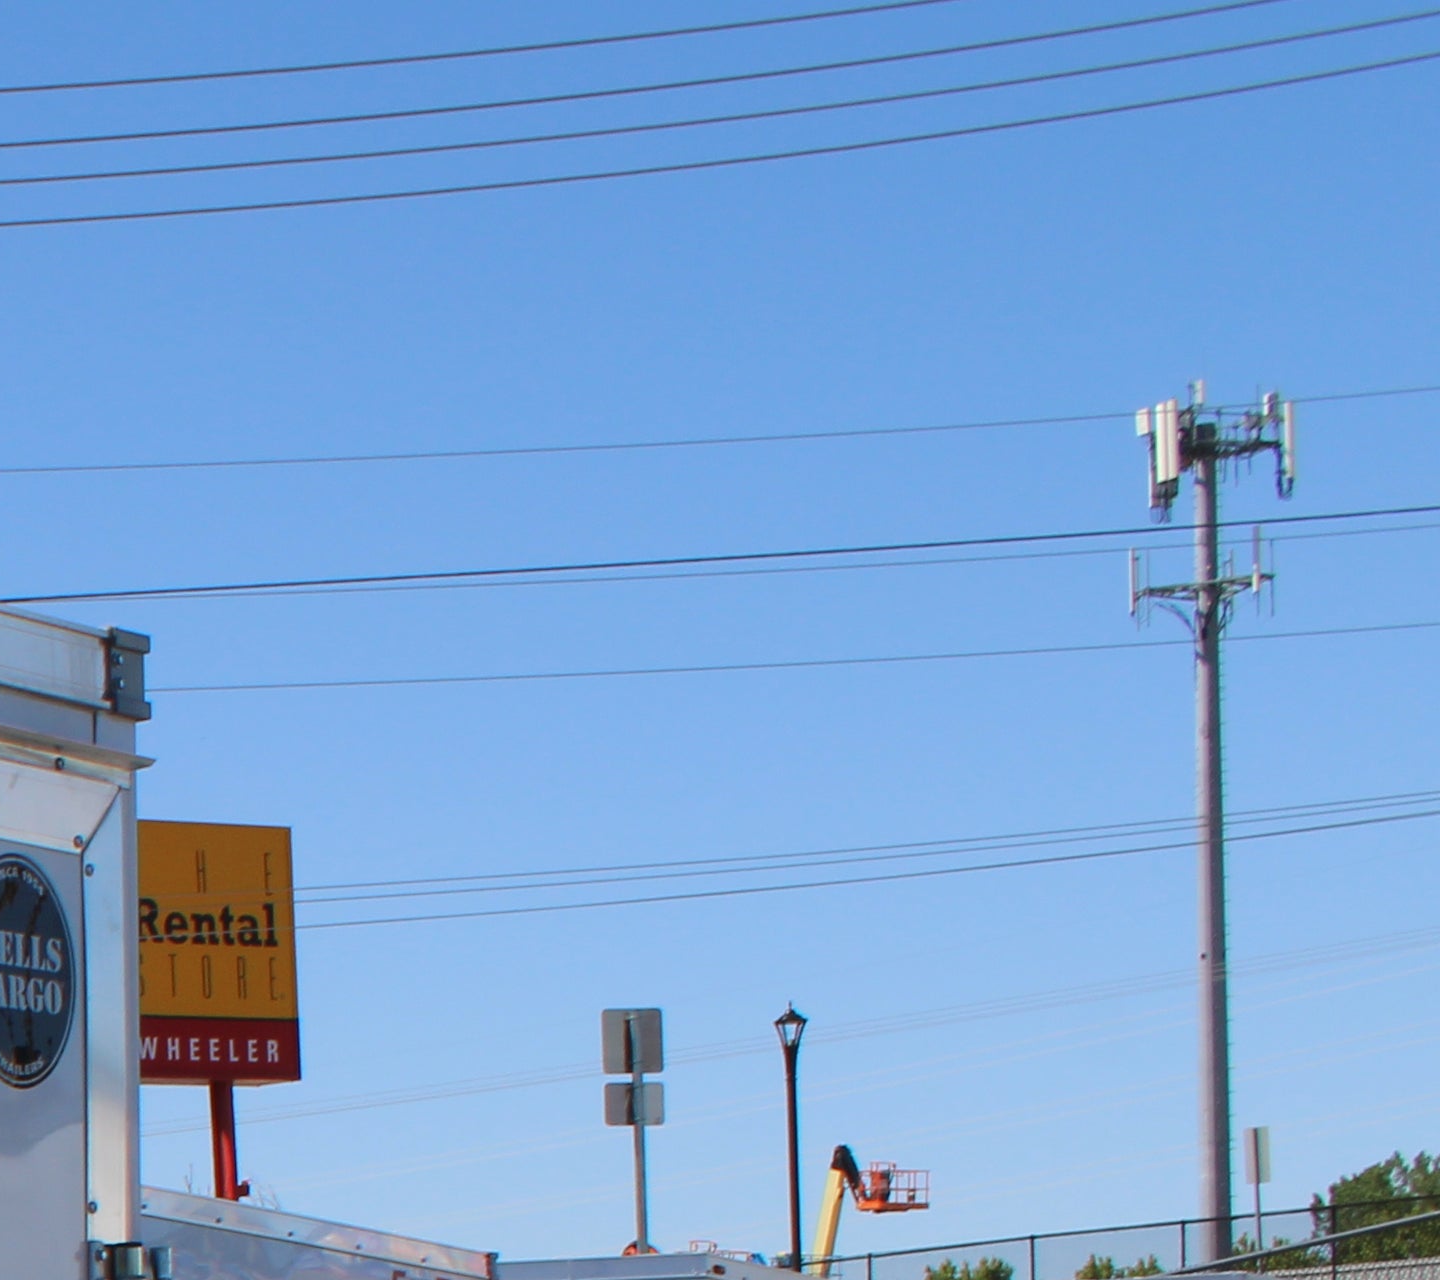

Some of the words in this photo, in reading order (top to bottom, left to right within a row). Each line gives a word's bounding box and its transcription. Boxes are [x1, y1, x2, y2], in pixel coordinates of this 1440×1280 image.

[195, 849, 273, 896] HE
[139, 898, 278, 947] Rental
[140, 1036, 279, 1063] WHEELER
